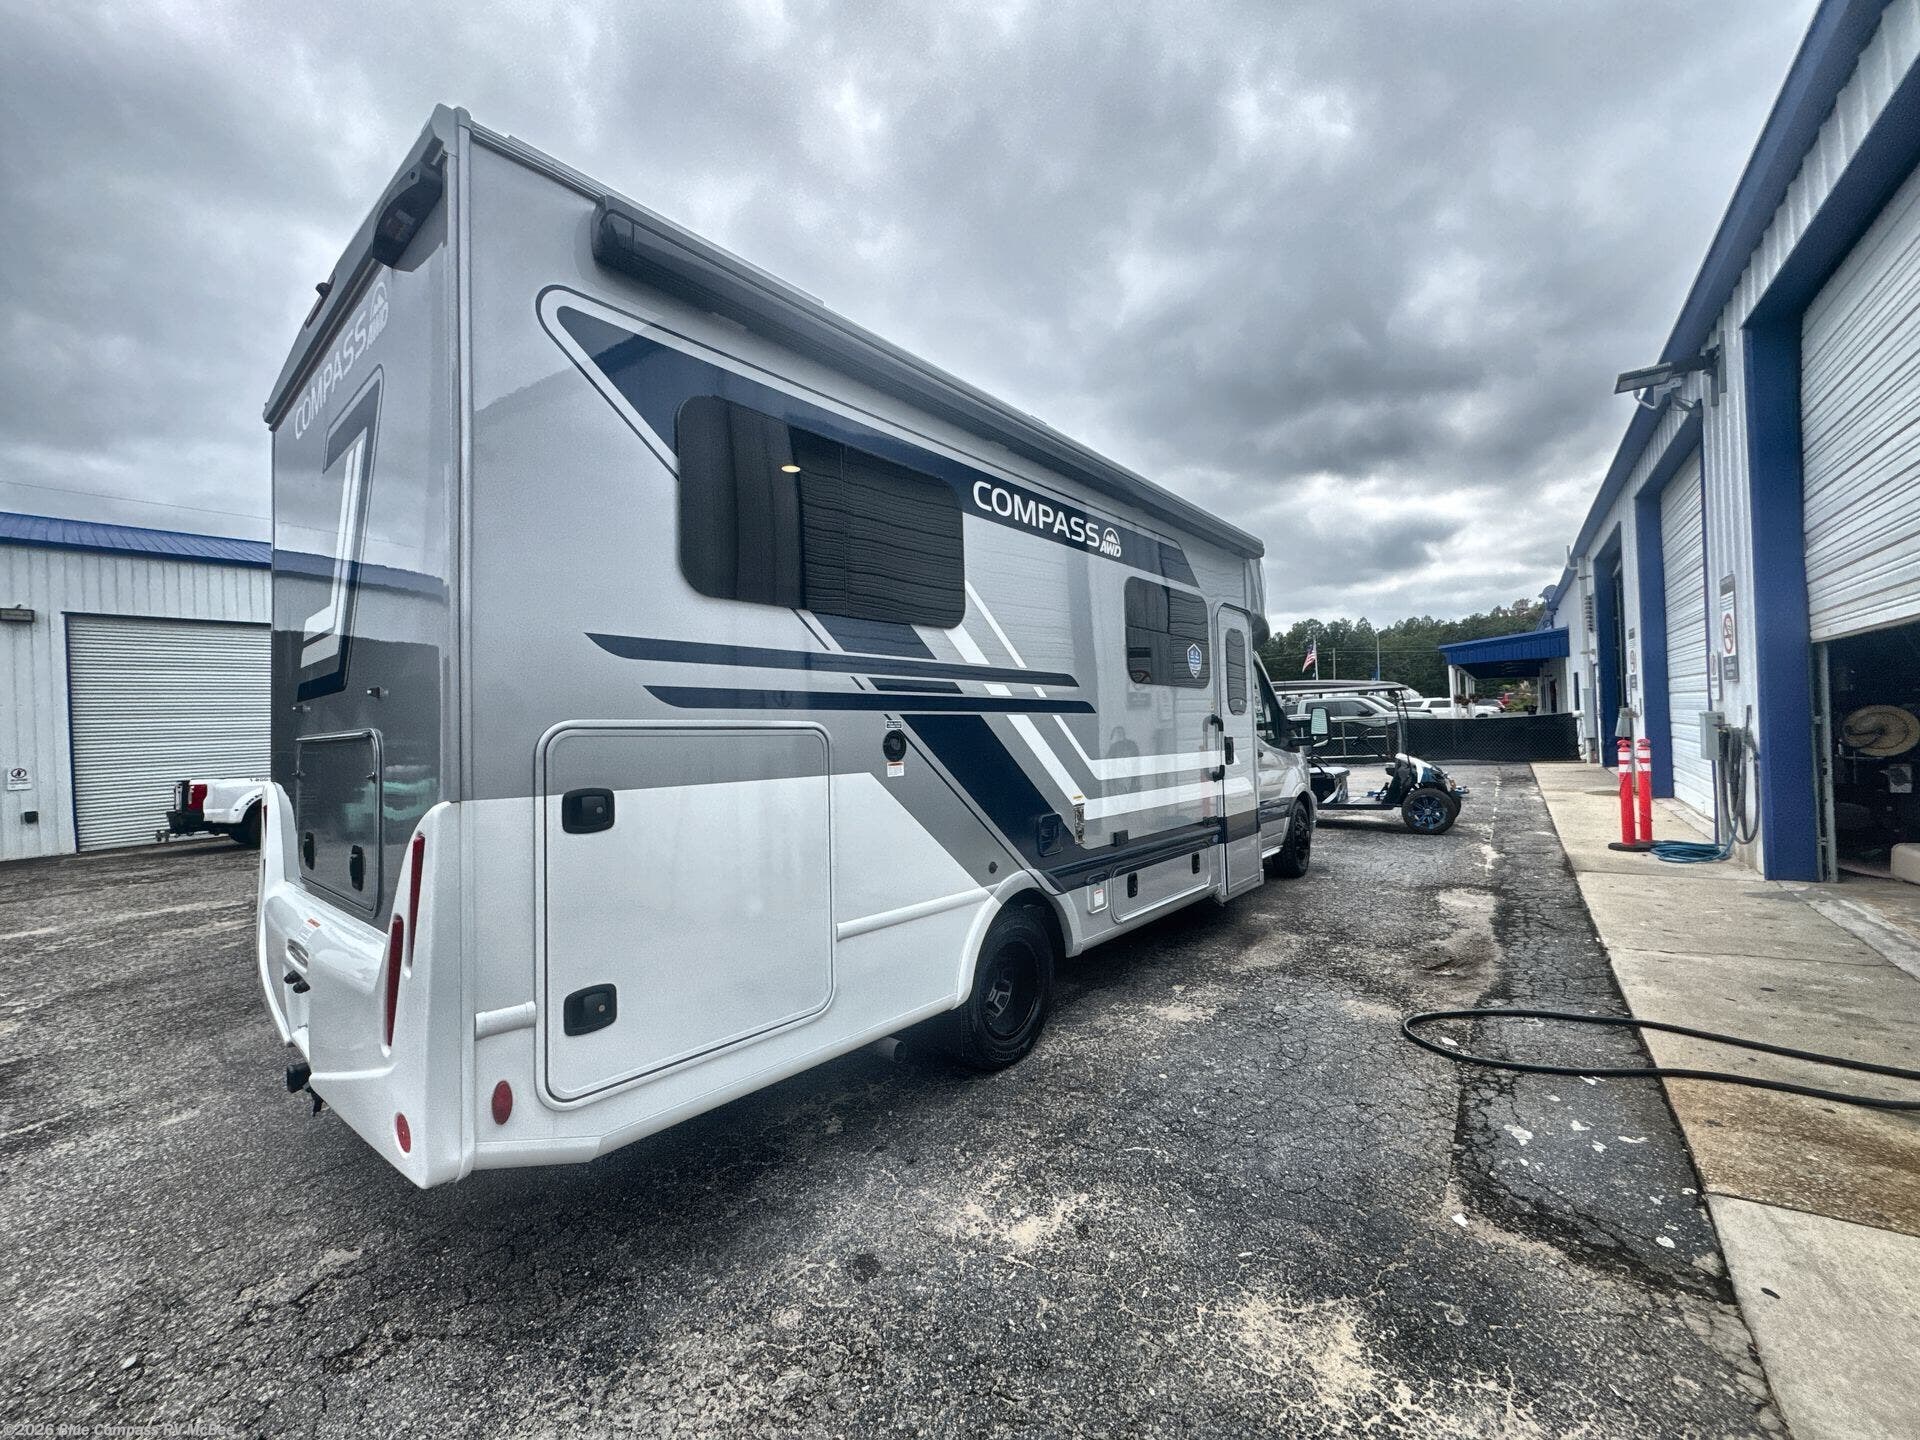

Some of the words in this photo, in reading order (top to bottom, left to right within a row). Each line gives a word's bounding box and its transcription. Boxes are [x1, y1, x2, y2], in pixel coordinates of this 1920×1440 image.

[295, 311, 368, 440] COMPASS
[973, 480, 1100, 548] COMPASS
[1099, 540, 1122, 557] AWD
